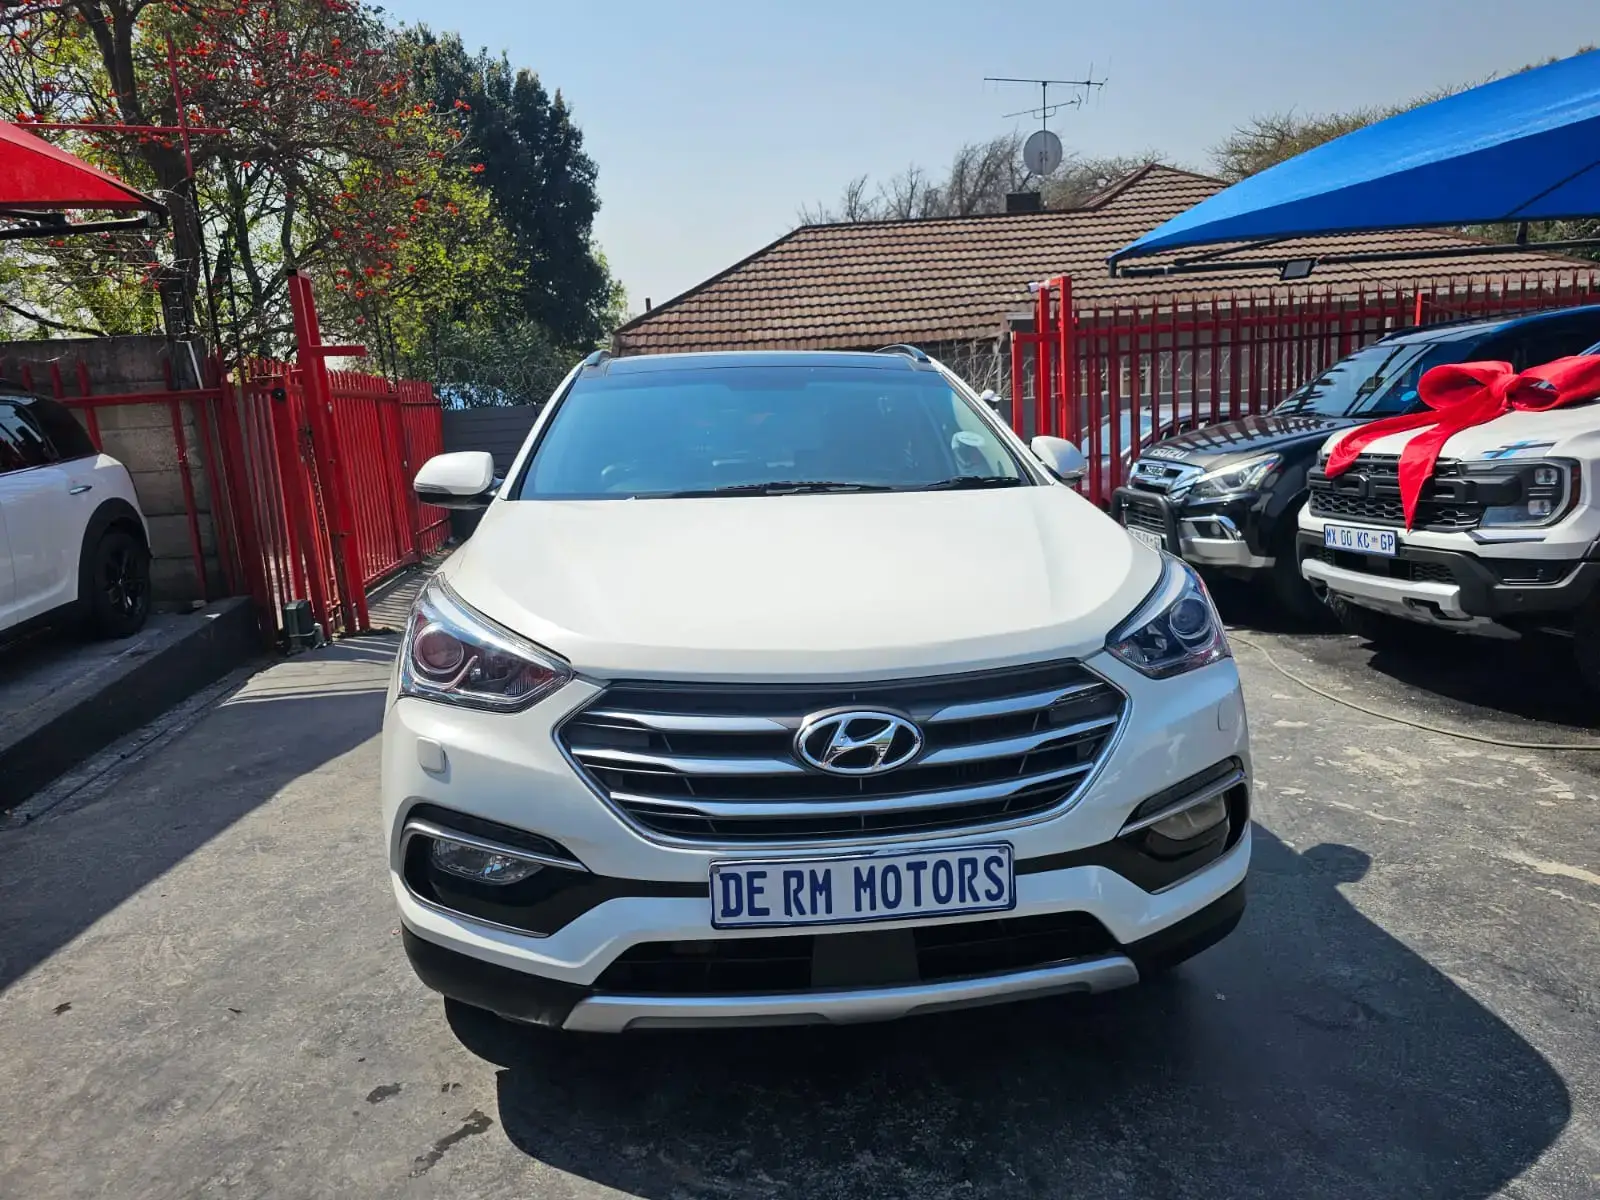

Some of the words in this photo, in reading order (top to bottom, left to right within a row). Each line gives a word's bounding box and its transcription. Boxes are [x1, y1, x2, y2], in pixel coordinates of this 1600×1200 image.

[1149, 448, 1190, 460] ISUZU
[1326, 528, 1337, 545] MX
[1357, 531, 1370, 548] KC
[1380, 534, 1394, 551] GP
[719, 871, 770, 918] DE
[783, 868, 833, 917] RM
[853, 855, 1005, 912] MOTORS
